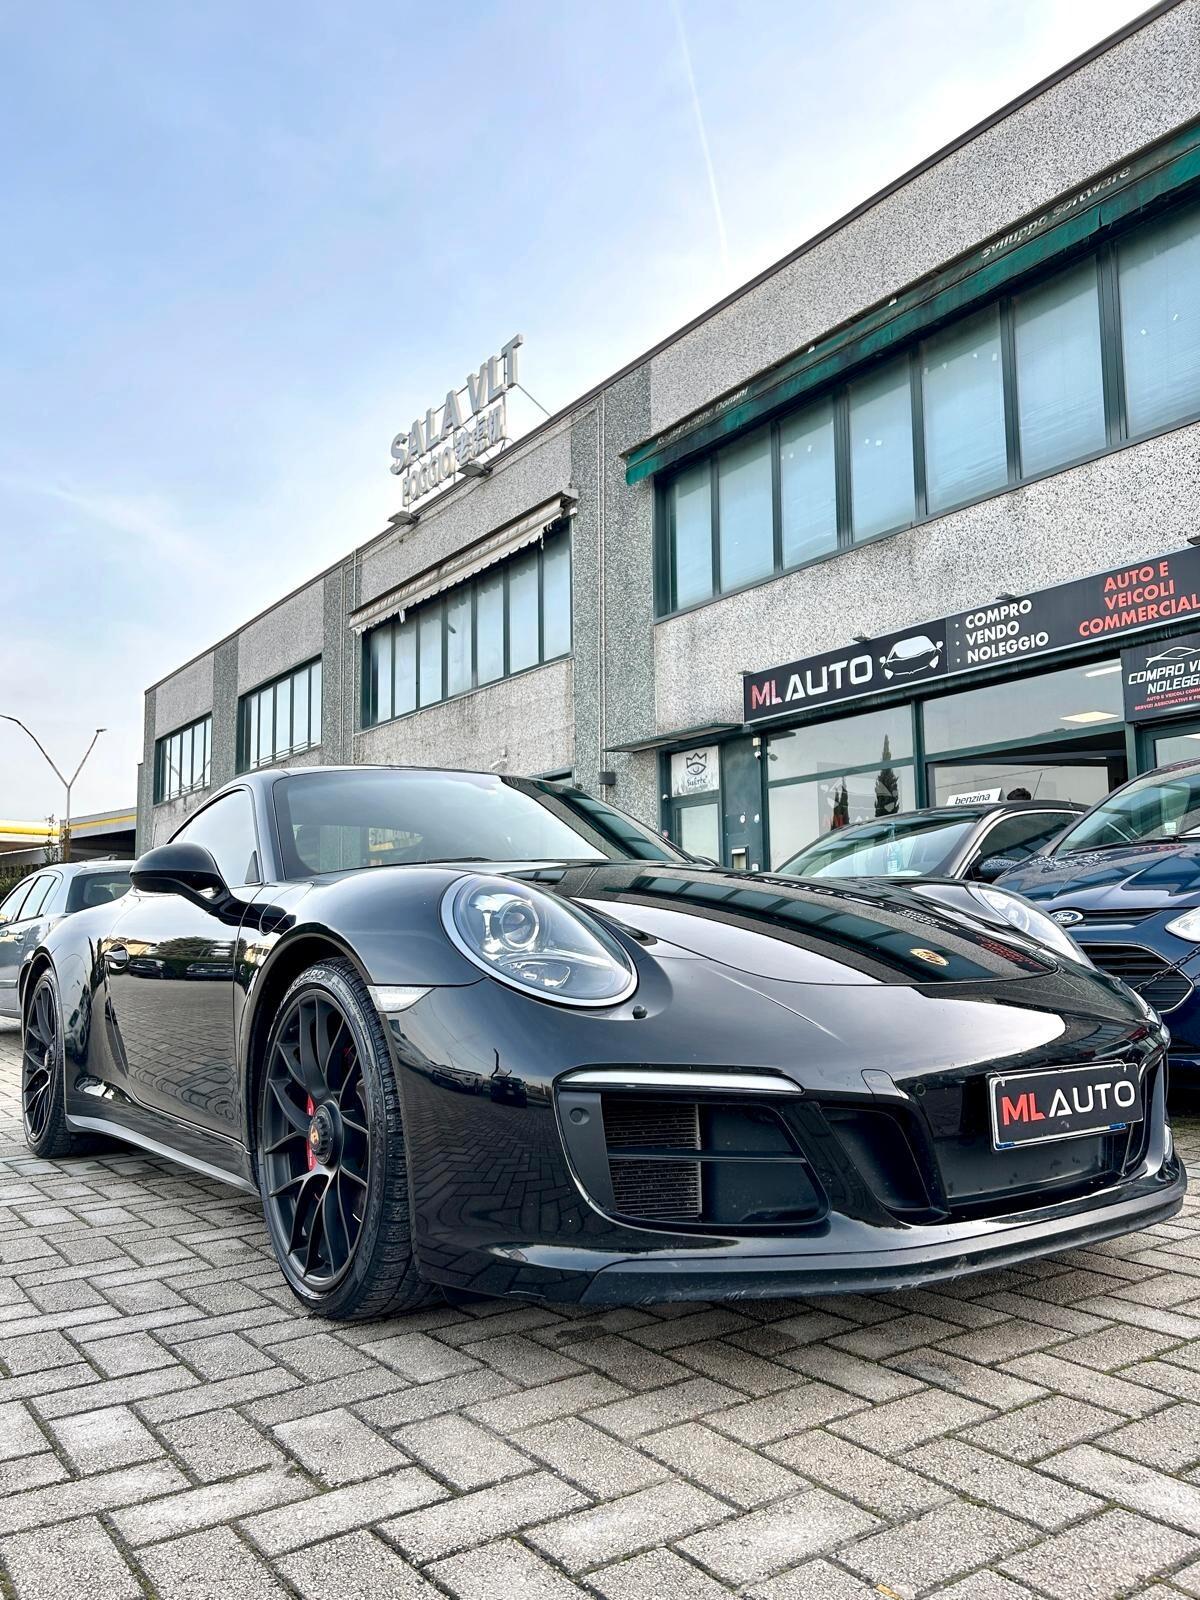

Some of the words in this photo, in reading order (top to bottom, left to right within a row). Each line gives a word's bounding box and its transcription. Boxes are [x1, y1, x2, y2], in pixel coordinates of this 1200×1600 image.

[390, 390, 463, 475] SALA
[467, 334, 524, 415] VLT
[402, 446, 456, 507] POGGIO
[1104, 566, 1154, 593] AUTO
[1159, 560, 1169, 577] E
[1104, 579, 1175, 610] VEICOLI
[965, 599, 1033, 629] COMPRO
[966, 620, 1021, 647] VENDO
[967, 631, 1050, 664] NOLEGGIO
[785, 654, 873, 702] AUTO
[1128, 663, 1185, 685] COMPRO
[1147, 673, 1200, 694] NOLEGG
[955, 793, 991, 805] benzina
[1001, 1092, 1046, 1126] ML
[1049, 1080, 1136, 1117] AUTO
